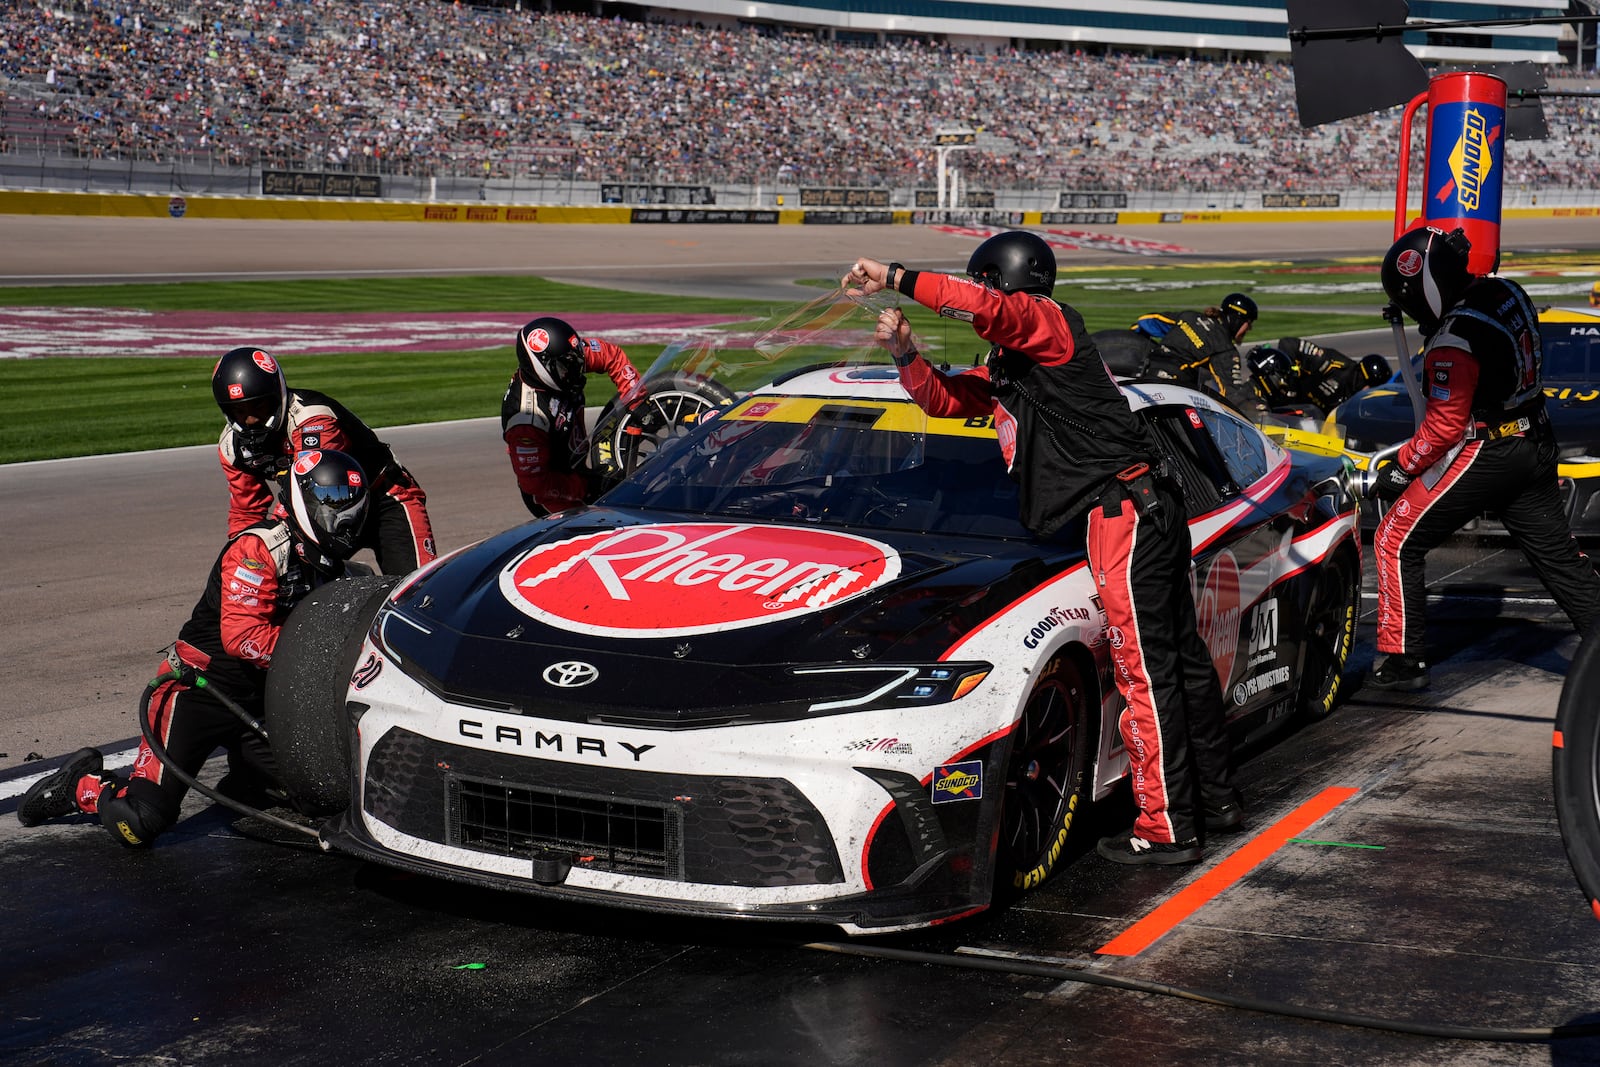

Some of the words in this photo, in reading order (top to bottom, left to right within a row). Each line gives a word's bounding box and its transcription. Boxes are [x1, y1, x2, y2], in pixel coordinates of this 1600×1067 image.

[1460, 113, 1486, 207] SUNOCO
[519, 526, 863, 608] Rheem
[458, 718, 656, 762] CAMRY
[937, 775, 979, 790] SUNOCO
